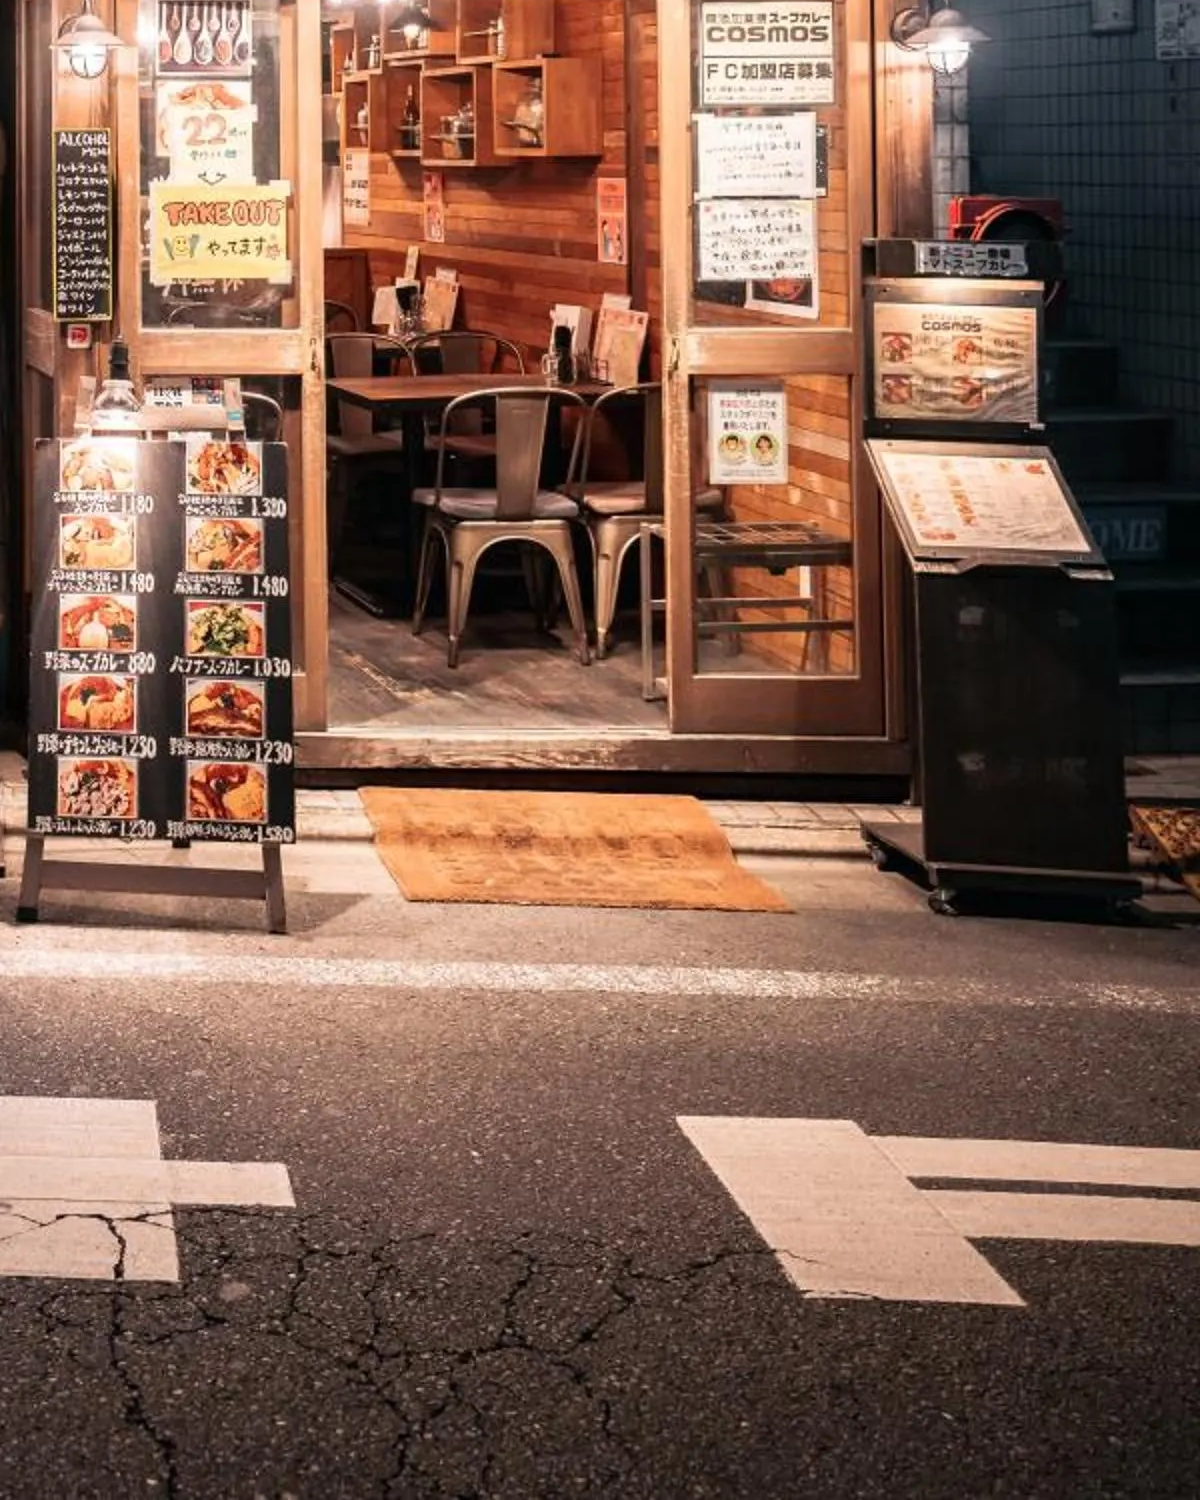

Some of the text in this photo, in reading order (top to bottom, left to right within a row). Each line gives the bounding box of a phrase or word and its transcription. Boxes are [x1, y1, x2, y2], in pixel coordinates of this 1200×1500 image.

[707, 26, 829, 42] COSMOS
[162, 199, 285, 227] TAKE OUT
